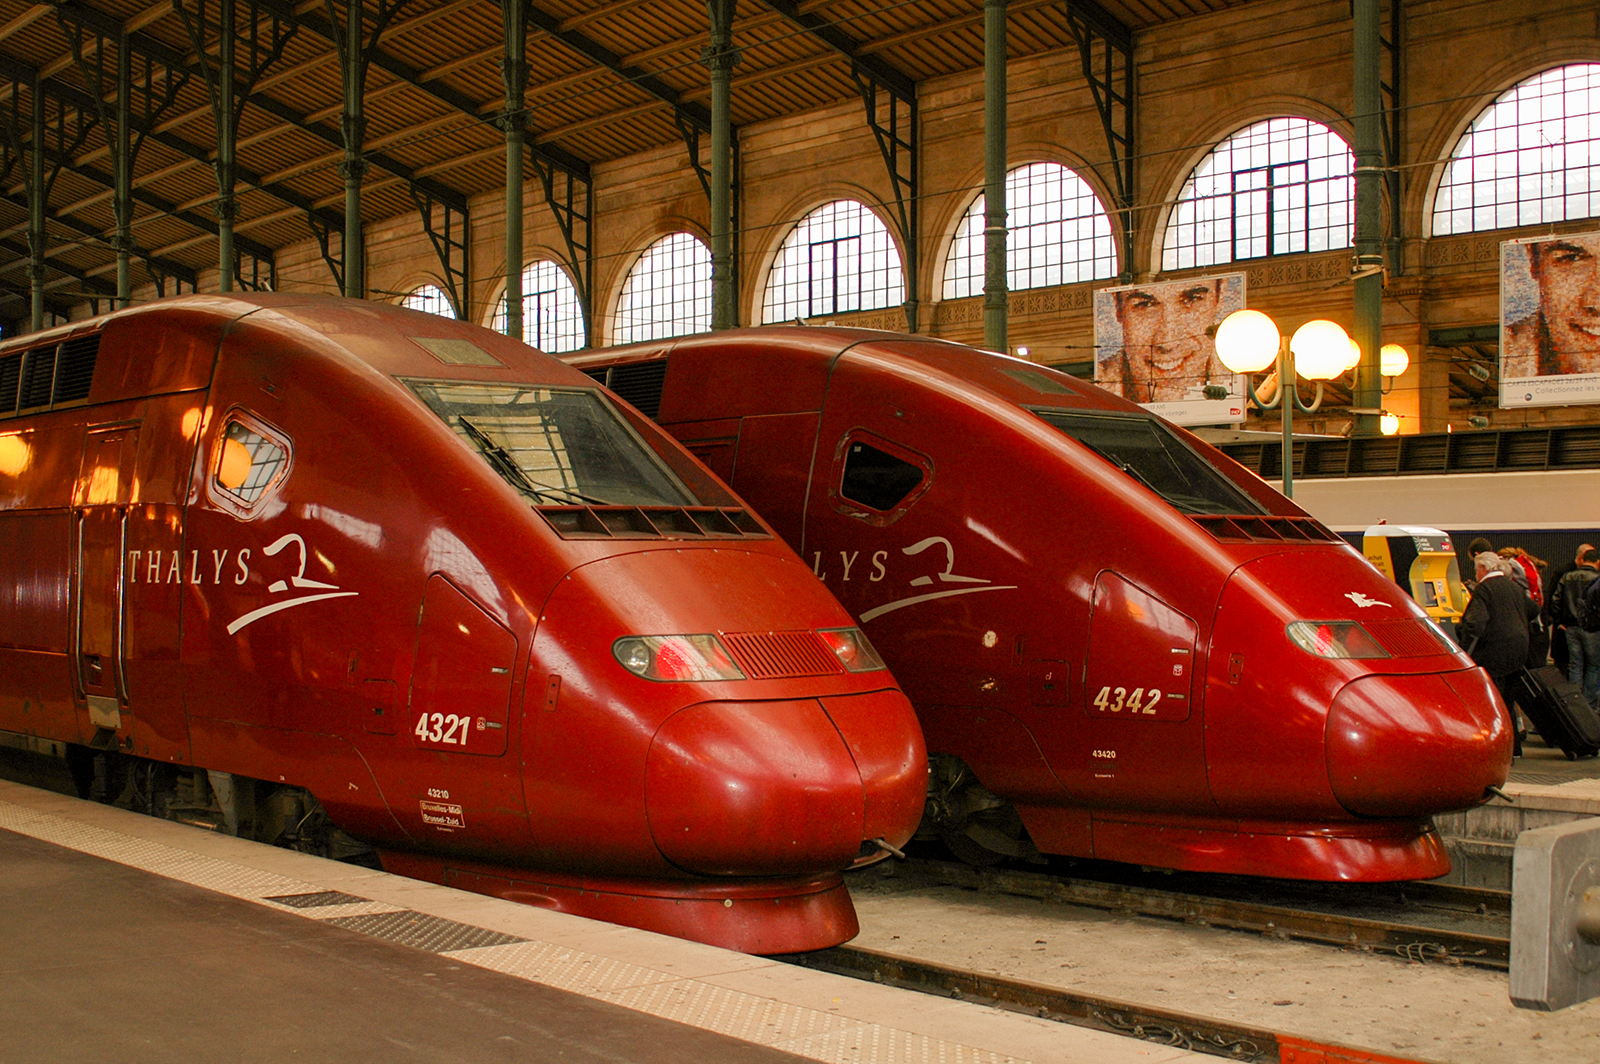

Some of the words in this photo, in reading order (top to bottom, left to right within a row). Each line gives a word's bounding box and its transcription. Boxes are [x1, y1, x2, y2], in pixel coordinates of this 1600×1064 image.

[1535, 386, 1583, 394] Collectionnez
[129, 549, 250, 584] THALYS
[1094, 686, 1161, 714] 4342
[415, 713, 470, 745] 4321
[1092, 750, 1115, 758] 43420
[428, 788, 449, 799] 43210
